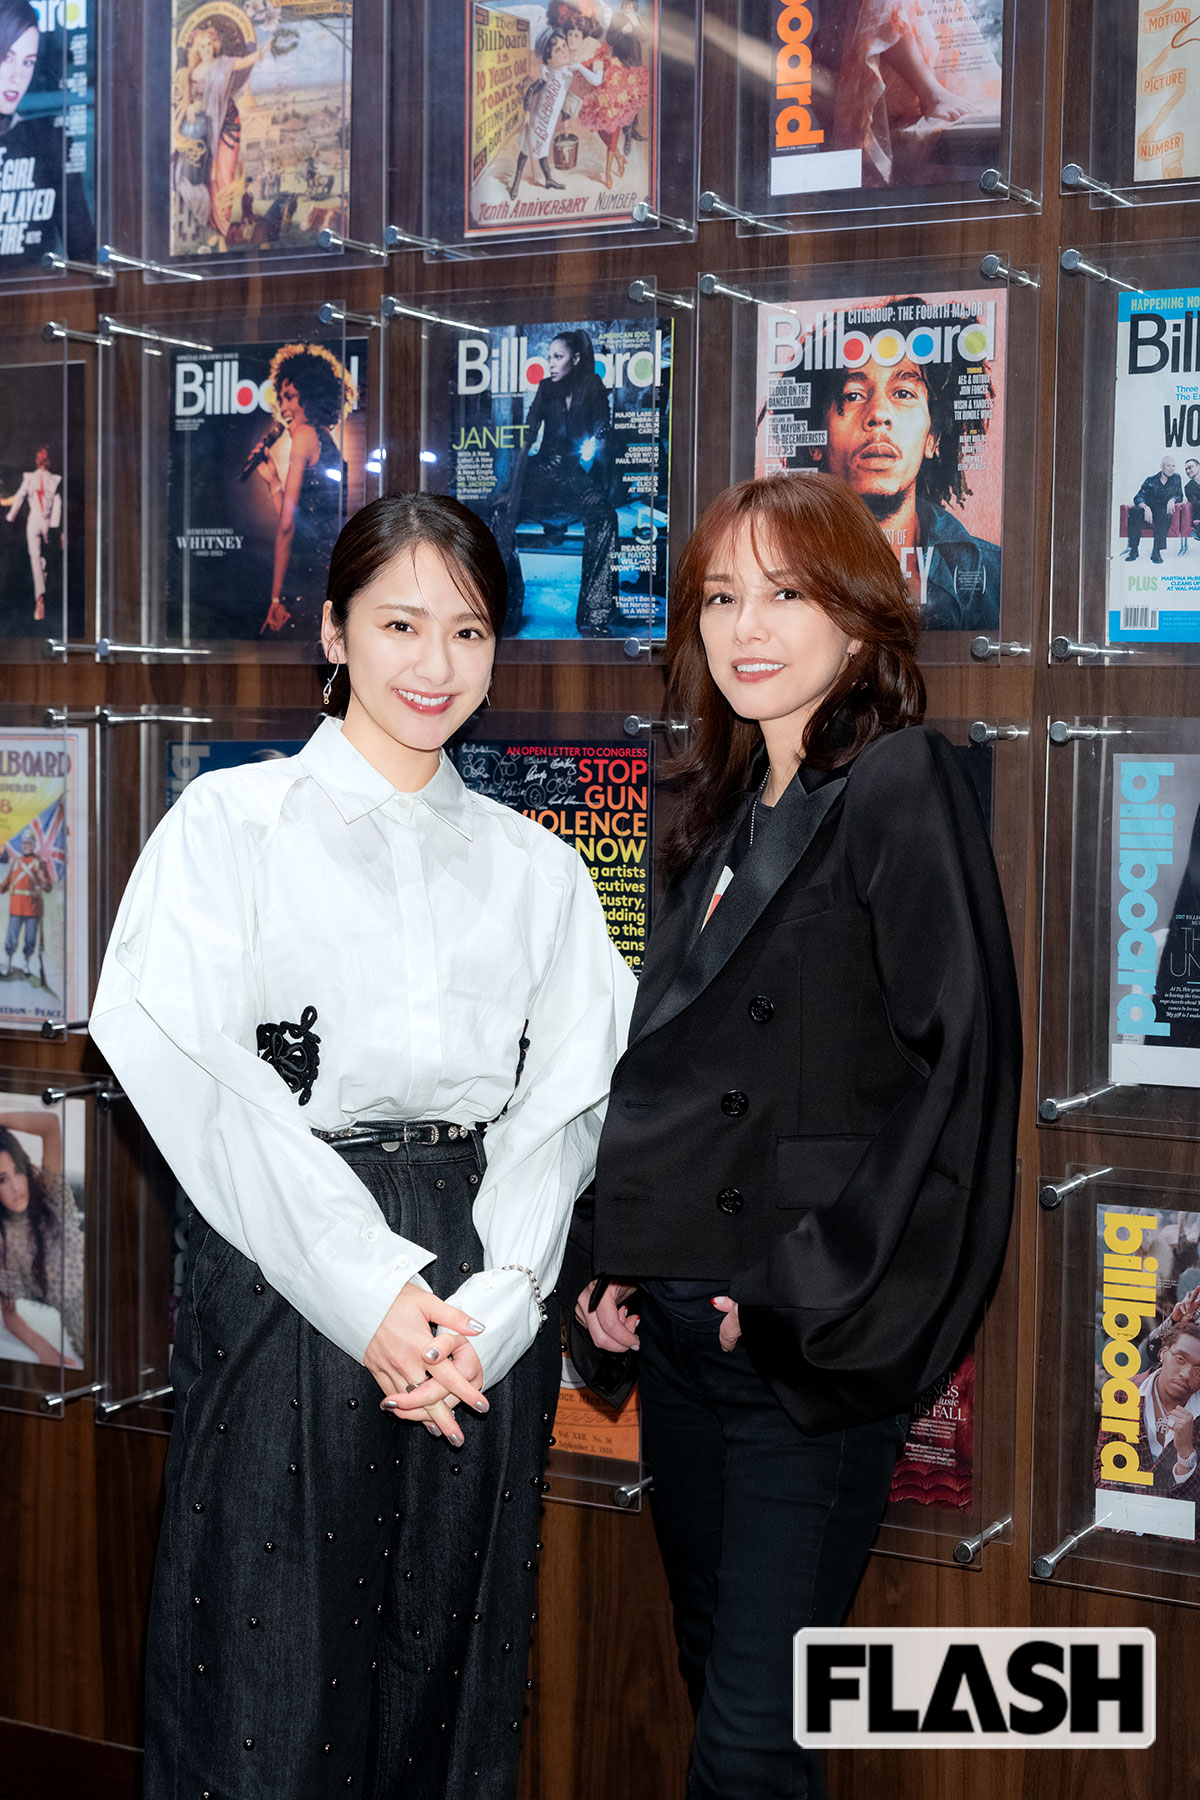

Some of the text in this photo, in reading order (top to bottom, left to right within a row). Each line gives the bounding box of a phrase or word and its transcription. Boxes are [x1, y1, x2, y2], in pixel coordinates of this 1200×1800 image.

[495, 16, 514, 30] The
[1148, 11, 1188, 32] MOTION
[477, 28, 527, 52] Billboard
[476, 70, 486, 95] 10
[1144, 72, 1183, 93] PICTURE
[1140, 136, 1181, 157] NUMBER
[848, 302, 983, 325] CITIGROUP: THE FOURTH MAJOR
[1131, 297, 1184, 311] HAPPENING
[767, 301, 996, 373] Billboard
[458, 329, 662, 395] Billbard
[788, 385, 797, 396] ON
[798, 384, 809, 395] THE
[1175, 385, 1199, 393] Three
[452, 425, 530, 450] JANET
[780, 422, 806, 433] MAYOR'S
[176, 536, 244, 551] WHITNEY
[897, 529, 908, 545] OF
[1128, 576, 1158, 592] PLUS
[506, 746, 648, 758] AN OPEN LETTER TO CONGRESS
[578, 759, 648, 784] STOP
[584, 785, 648, 811] GUN
[575, 837, 647, 863] NOW
[601, 864, 646, 879] artists
[1117, 762, 1175, 1037] billboard
[607, 923, 645, 937] to the
[1101, 1212, 1159, 1486] billboard
[933, 1405, 967, 1422] FALL
[558, 1440, 588, 1451] September
